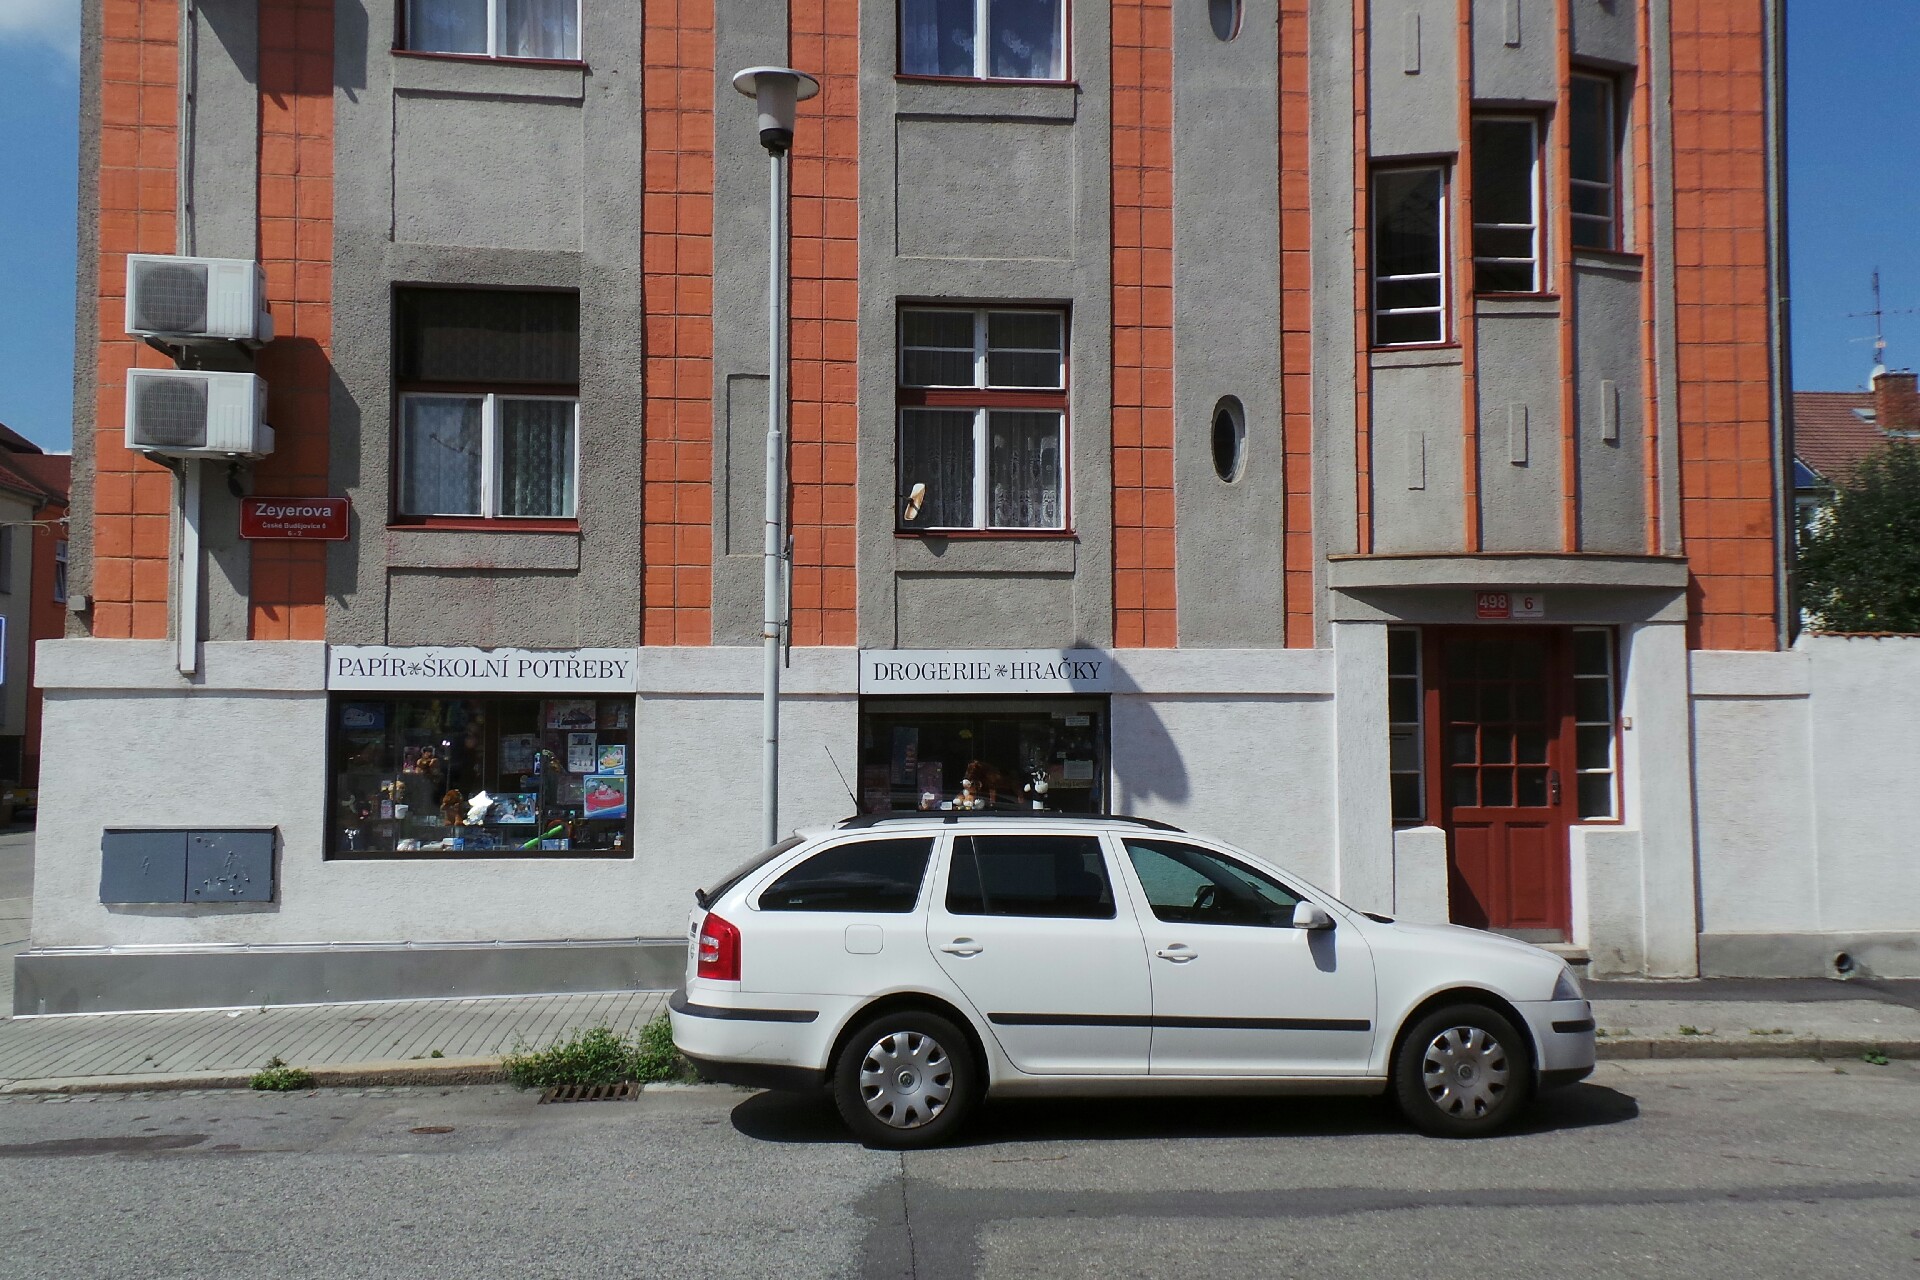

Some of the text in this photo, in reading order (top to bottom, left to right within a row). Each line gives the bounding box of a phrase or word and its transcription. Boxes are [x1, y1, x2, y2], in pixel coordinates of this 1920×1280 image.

[255, 503, 332, 519] Zeyerova
[1480, 594, 1507, 608] 498
[1524, 597, 1533, 610] 6
[517, 655, 629, 679] POTŘEBY
[873, 657, 1102, 682] DROGERIE HRAČKY
